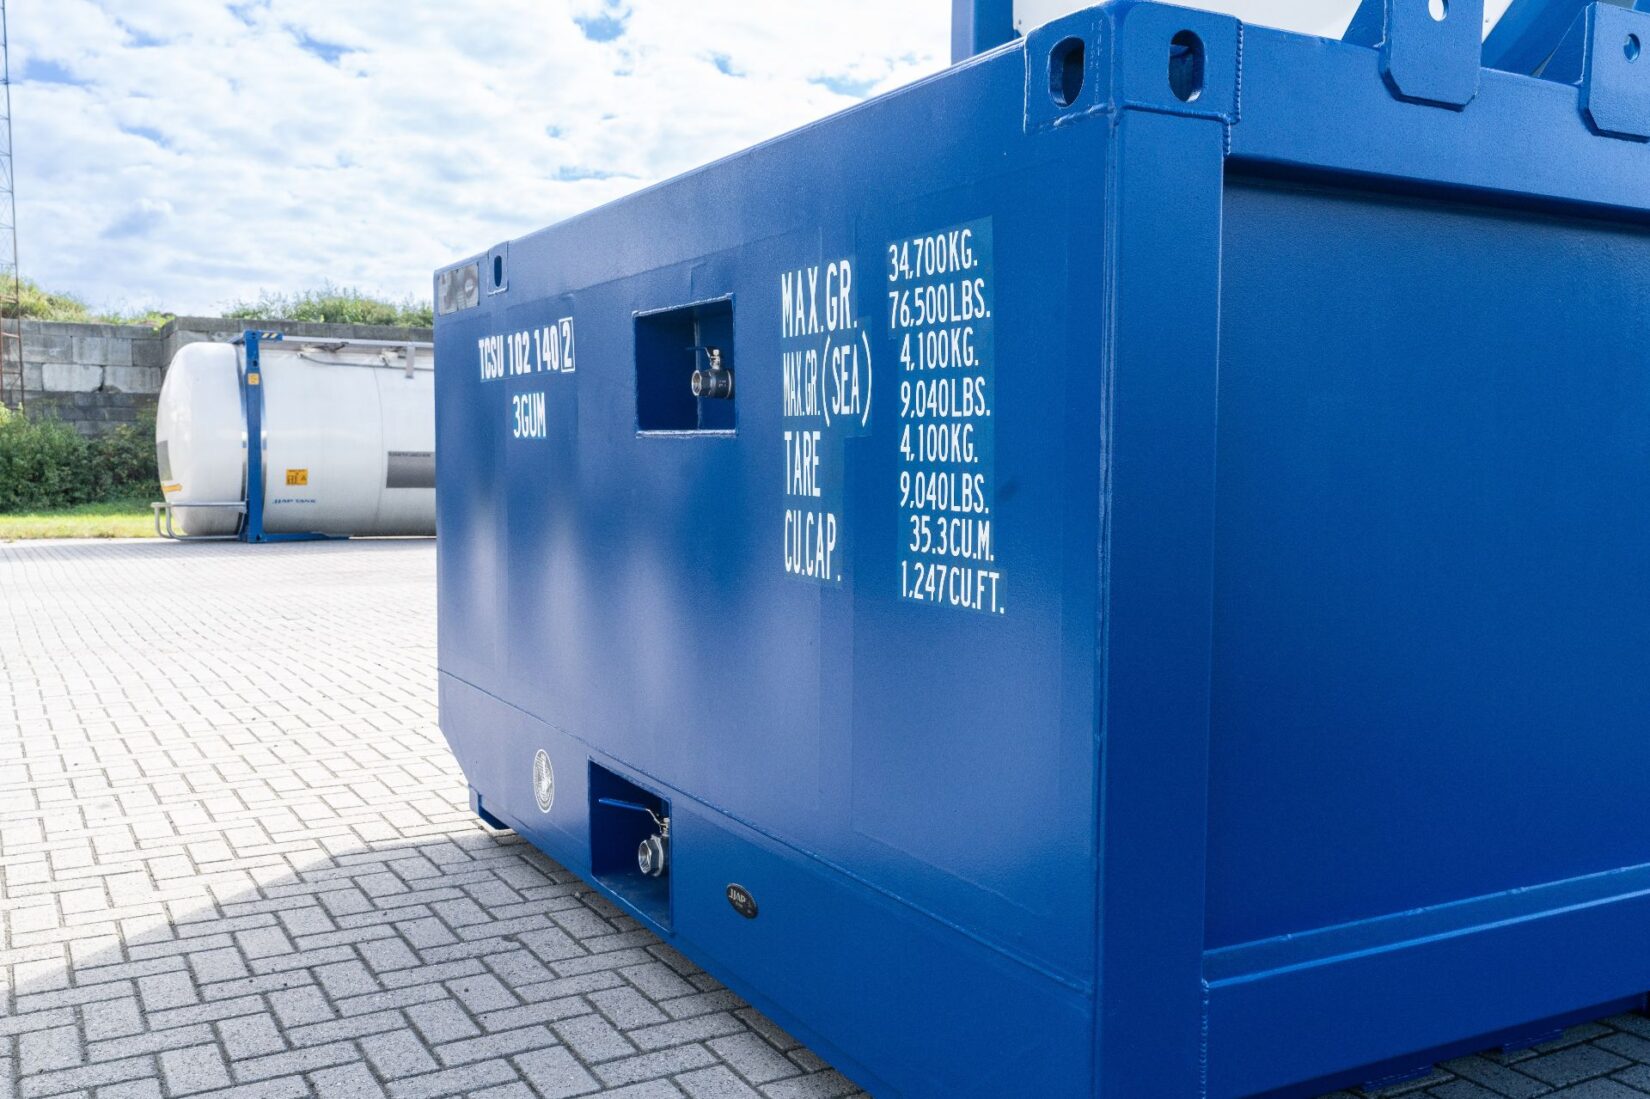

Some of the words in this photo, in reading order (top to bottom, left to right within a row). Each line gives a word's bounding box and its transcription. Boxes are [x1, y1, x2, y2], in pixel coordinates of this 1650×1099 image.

[781, 259, 857, 338] MAX.GR.
[478, 335, 505, 380] TCSU
[507, 330, 532, 375] 102
[533, 325, 559, 371] 140
[512, 392, 547, 439] 3GUM
[784, 430, 821, 498] TARE
